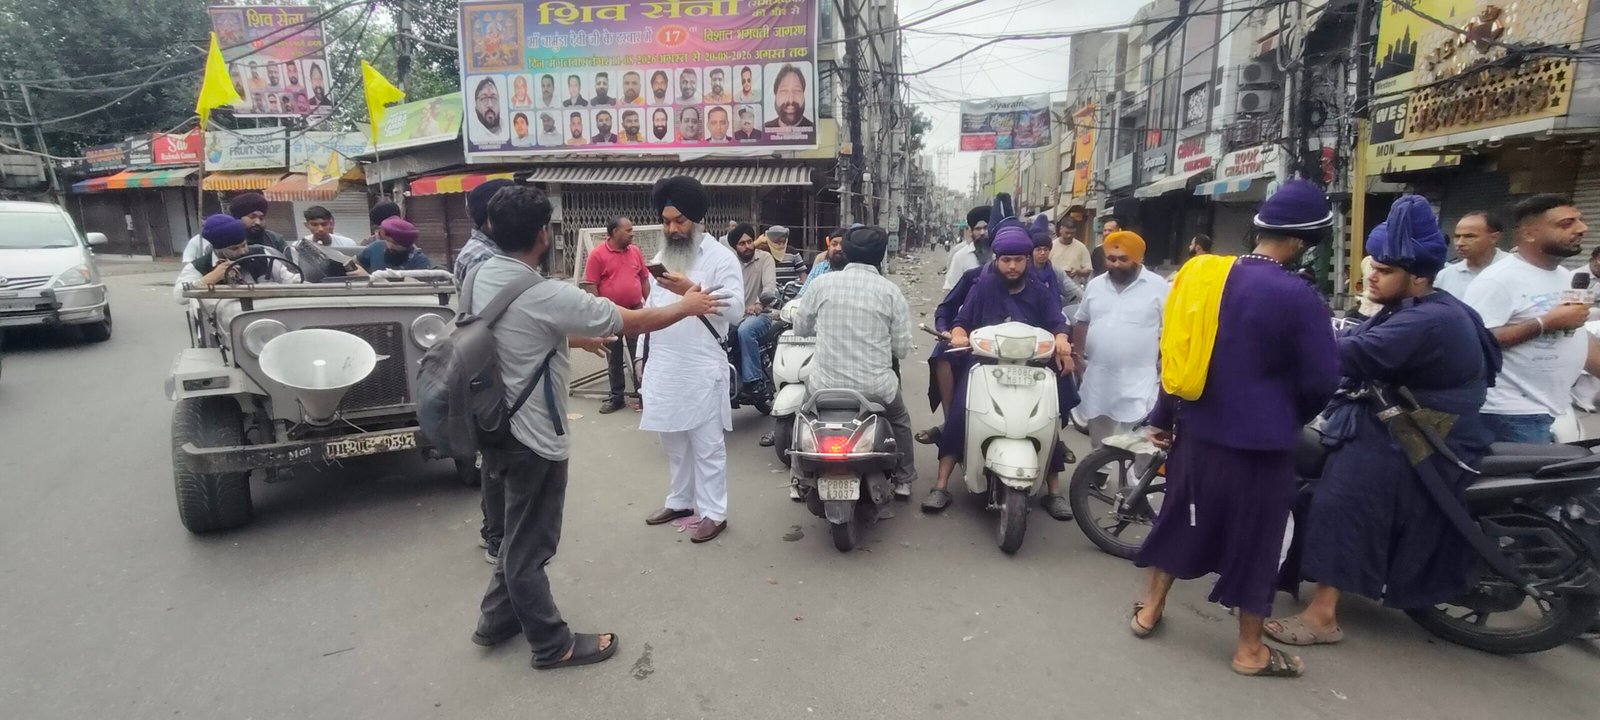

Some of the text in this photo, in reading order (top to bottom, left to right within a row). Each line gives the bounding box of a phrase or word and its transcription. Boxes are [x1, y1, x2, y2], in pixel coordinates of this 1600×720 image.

[246, 8, 273, 28] शिव
[537, 0, 740, 25] शिव सेना
[664, 31, 681, 42] 17
[704, 28, 732, 41] विशाल
[736, 25, 769, 40] भगवती
[773, 25, 807, 37] जागरण
[705, 50, 752, 61] 20-08-2026
[755, 48, 786, 59] अगस्त
[790, 47, 808, 58] तक
[1376, 103, 1407, 123] WES
[1394, 119, 1405, 134] U
[229, 145, 254, 157] FRUIT
[256, 144, 281, 154] SHOP
[1234, 149, 1259, 165] ROOP
[1376, 144, 1395, 157] MON
